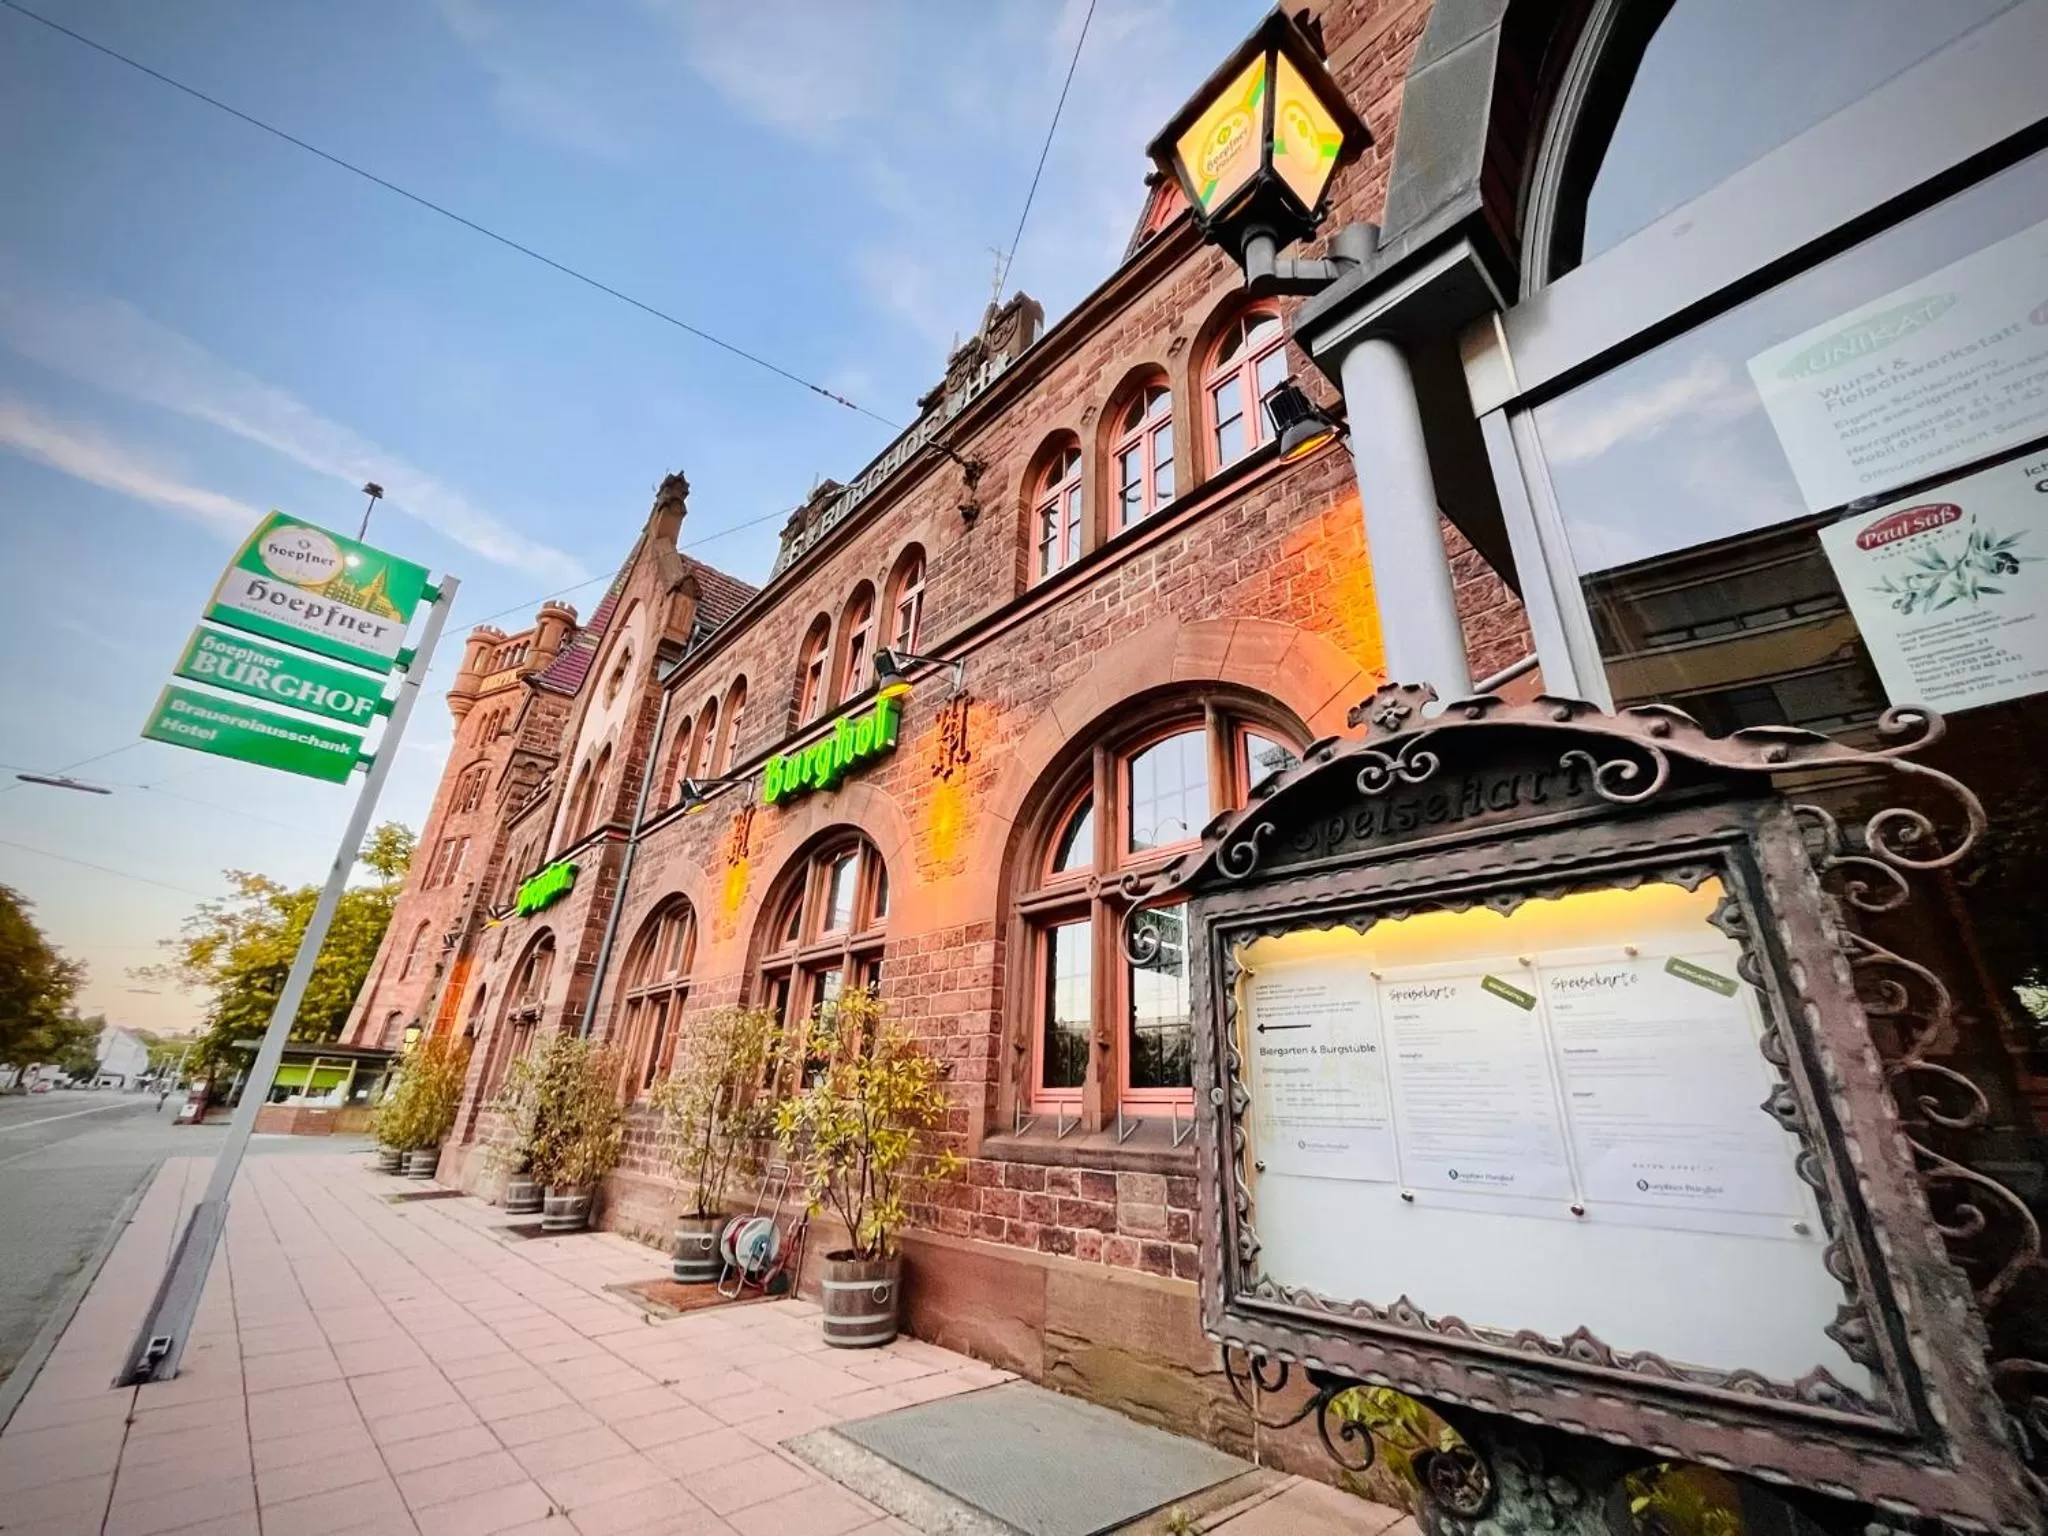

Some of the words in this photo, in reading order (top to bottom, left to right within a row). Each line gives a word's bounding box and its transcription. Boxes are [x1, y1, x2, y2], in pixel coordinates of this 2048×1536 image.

[1818, 366, 1884, 399] Wurst
[1892, 356, 1908, 370] &
[1825, 323, 2019, 411] Fleischwerkstatt
[1863, 521, 1909, 546] Paul
[1912, 505, 1956, 529] Süß
[190, 651, 375, 717] BURGHOF
[159, 718, 219, 742] Hotel
[169, 699, 352, 756] Brauereiausschank
[1551, 971, 1639, 992] Speisekarte
[1259, 1047, 1308, 1057] Biergarten
[1310, 1046, 1317, 1054] &
